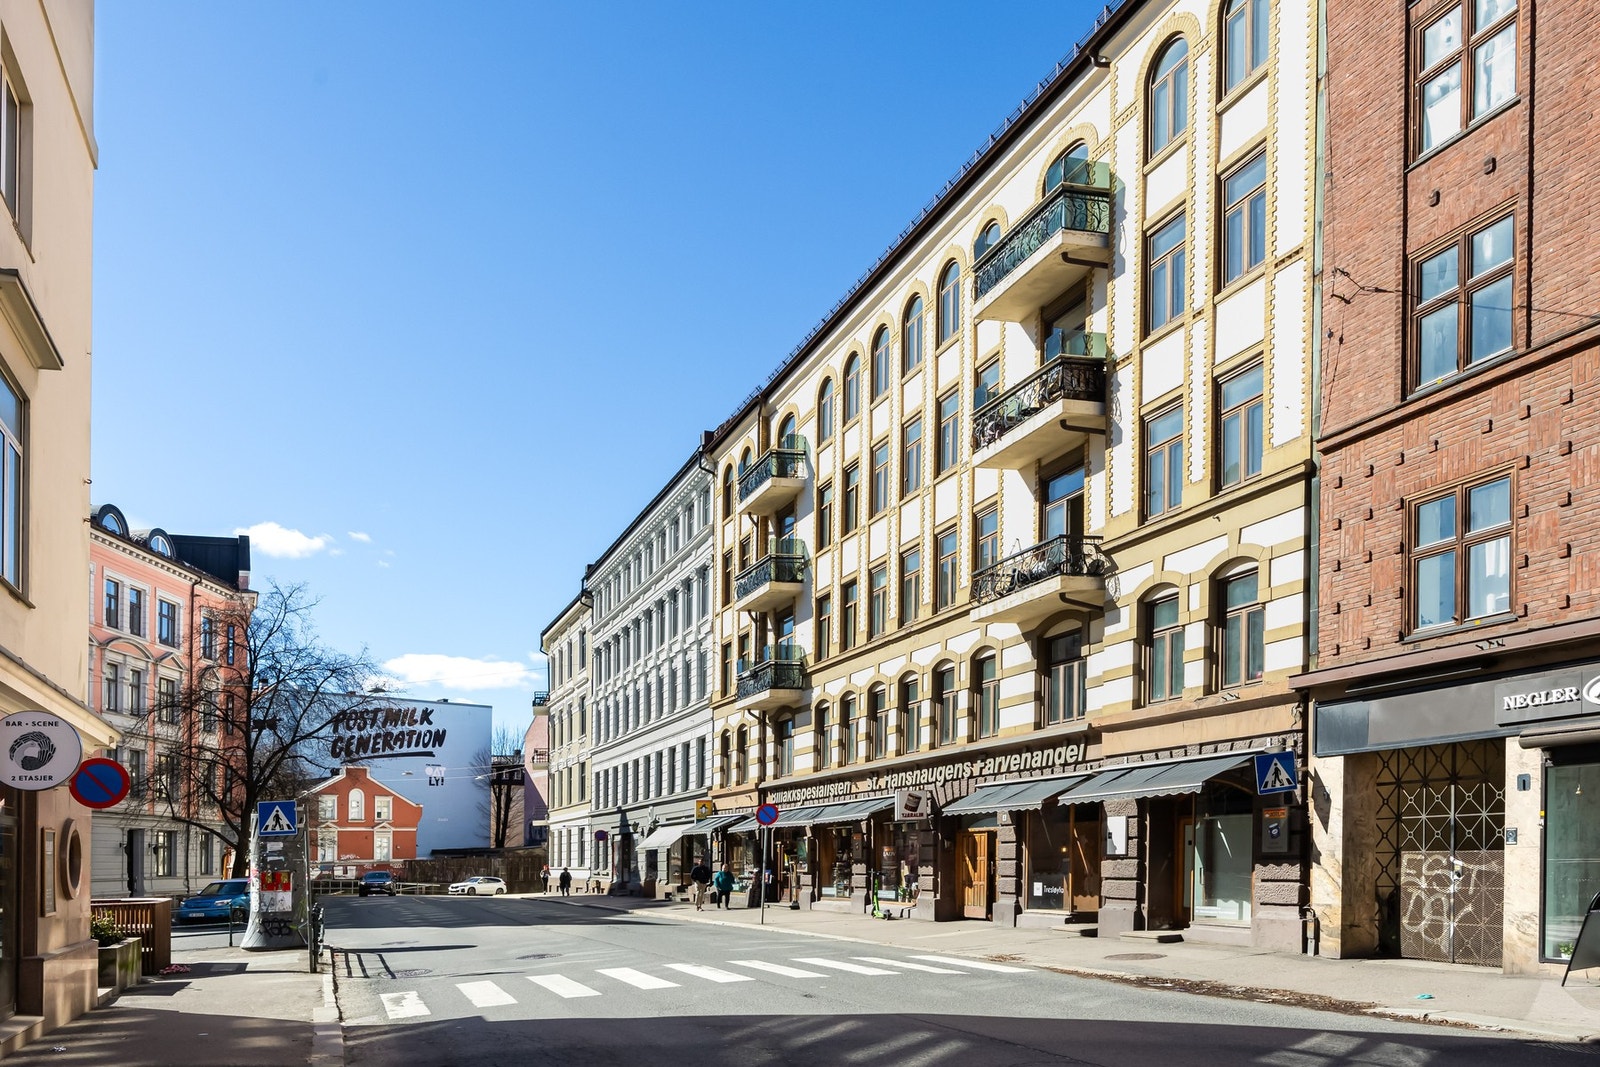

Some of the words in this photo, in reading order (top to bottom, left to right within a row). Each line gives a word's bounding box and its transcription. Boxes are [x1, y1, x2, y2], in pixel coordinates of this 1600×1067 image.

[1503, 687, 1579, 710] NEGLER
[332, 708, 382, 734] POST
[382, 707, 434, 729] MILK
[331, 728, 447, 758] GENERATION
[425, 766, 446, 777] OAT
